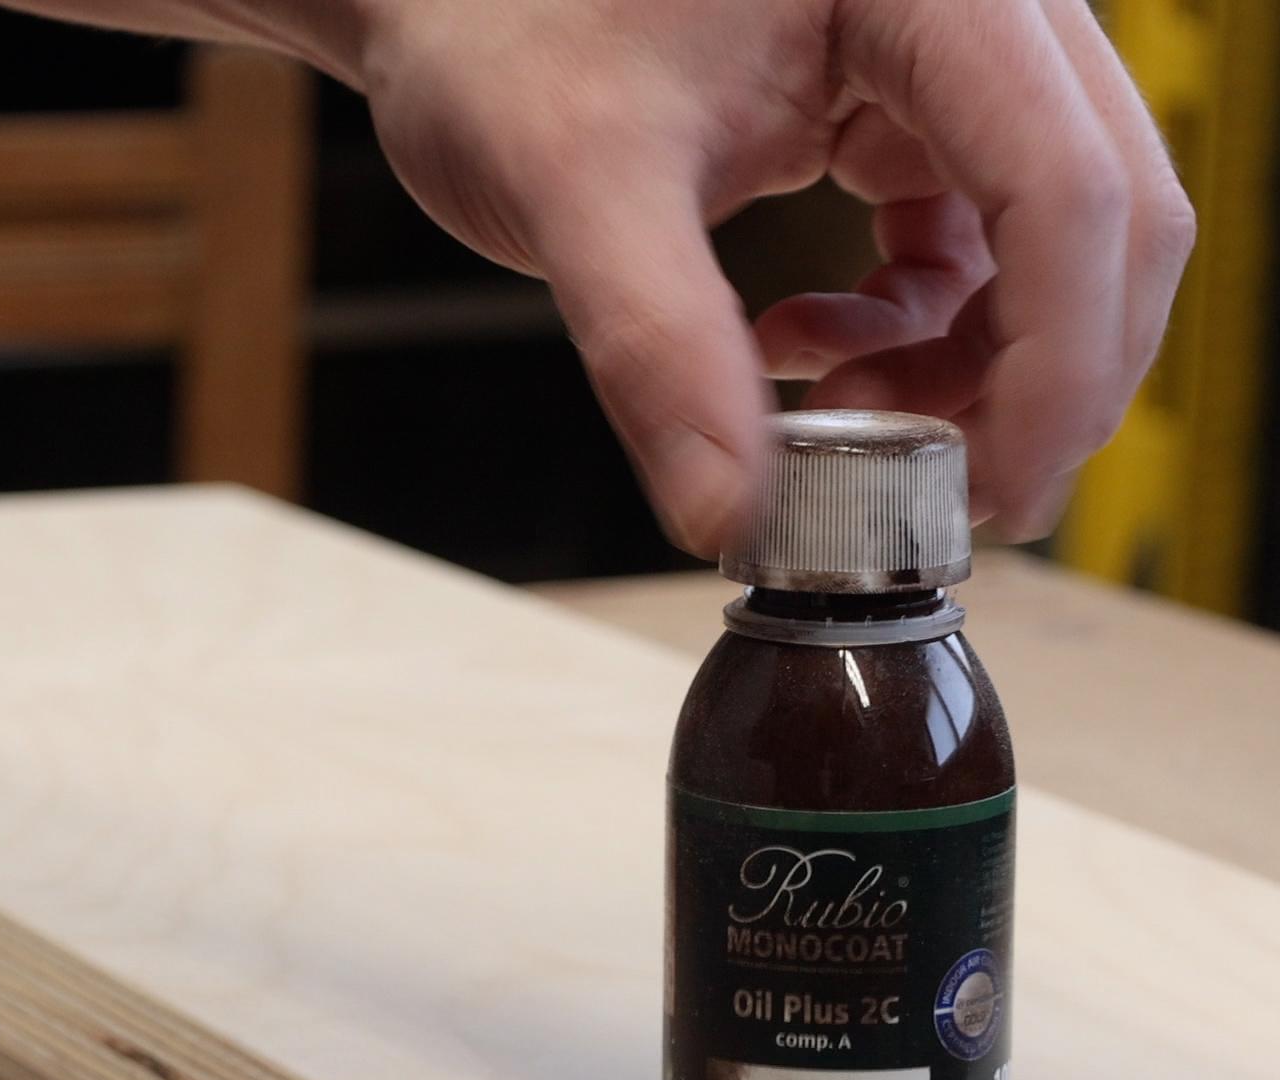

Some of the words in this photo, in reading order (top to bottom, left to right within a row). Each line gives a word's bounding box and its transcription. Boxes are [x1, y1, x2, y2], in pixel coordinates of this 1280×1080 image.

[727, 926, 909, 962] MONOCOAT
[733, 988, 772, 1021] Oil
[783, 993, 850, 1025] Plus
[860, 996, 900, 1025] 2C
[775, 1031, 833, 1052] comp.
[838, 1032, 852, 1050] A
